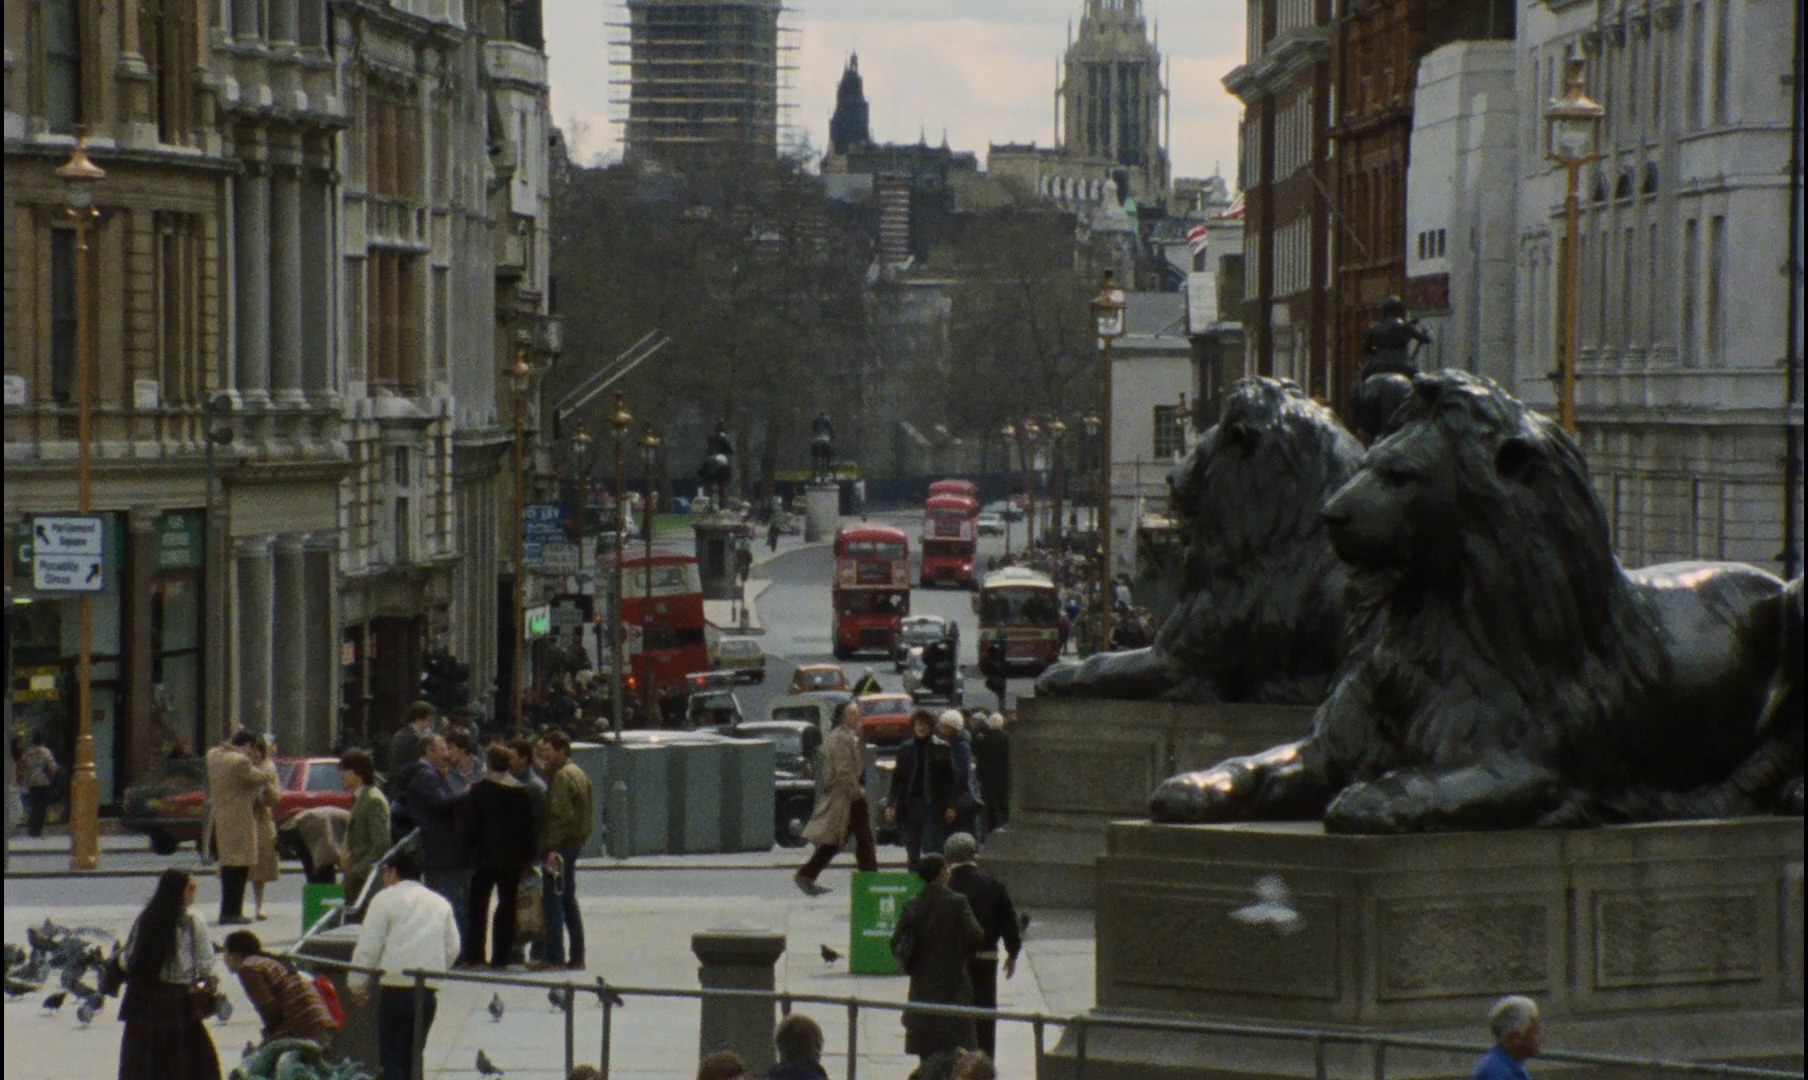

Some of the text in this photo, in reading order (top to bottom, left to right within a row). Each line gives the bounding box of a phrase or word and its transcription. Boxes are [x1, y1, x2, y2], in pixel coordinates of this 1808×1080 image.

[51, 523, 95, 533] Parliament
[60, 536, 86, 547] Square
[39, 561, 79, 572] Piccadilly
[44, 574, 71, 584] Circus
